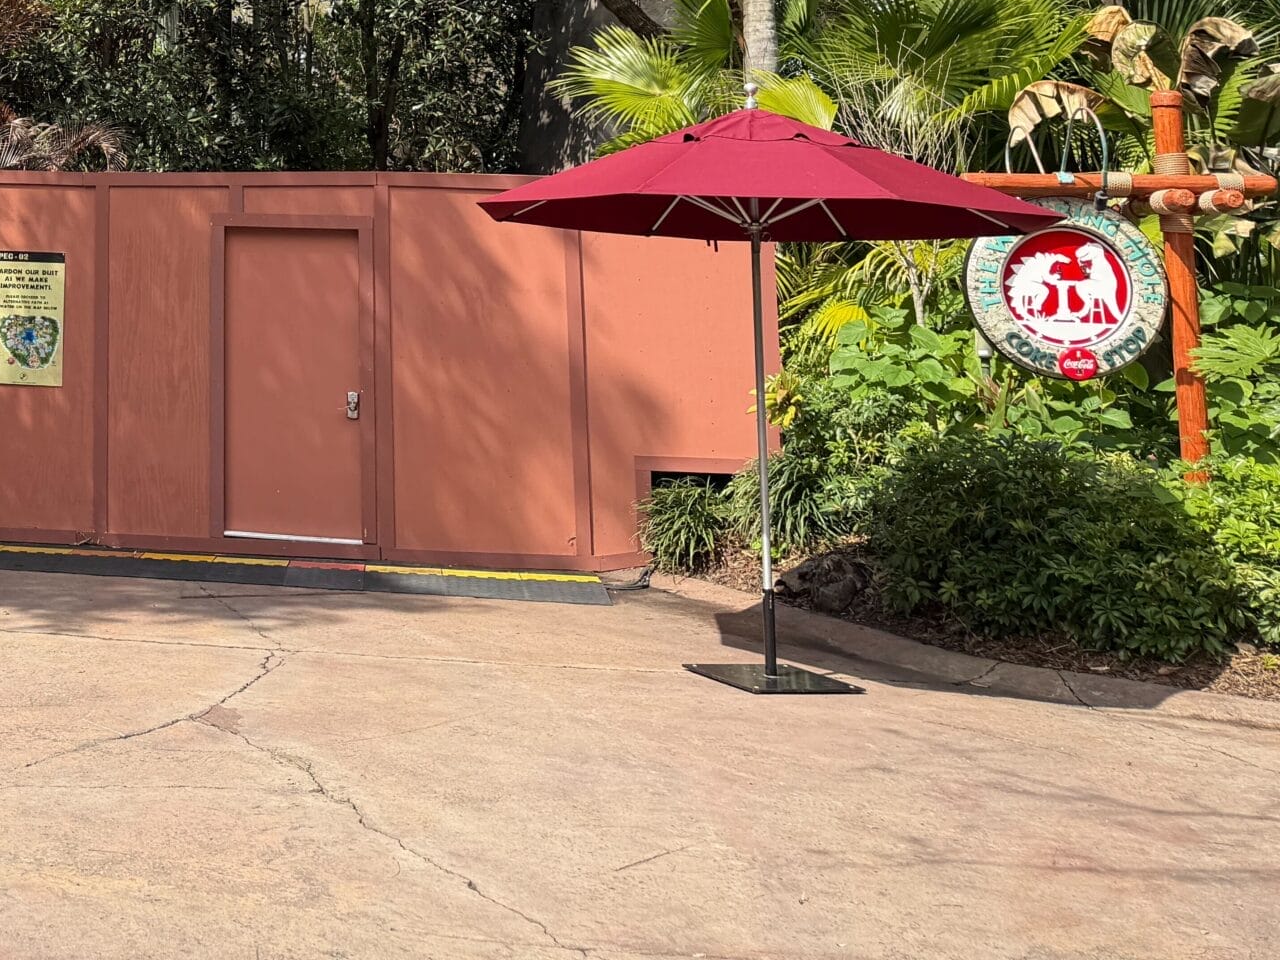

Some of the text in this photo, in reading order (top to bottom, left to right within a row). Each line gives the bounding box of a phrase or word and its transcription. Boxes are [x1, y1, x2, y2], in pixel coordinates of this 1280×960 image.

[980, 262, 1001, 312] THE
[1122, 237, 1163, 305] HOLE
[1006, 326, 1147, 369] COKE STOP
